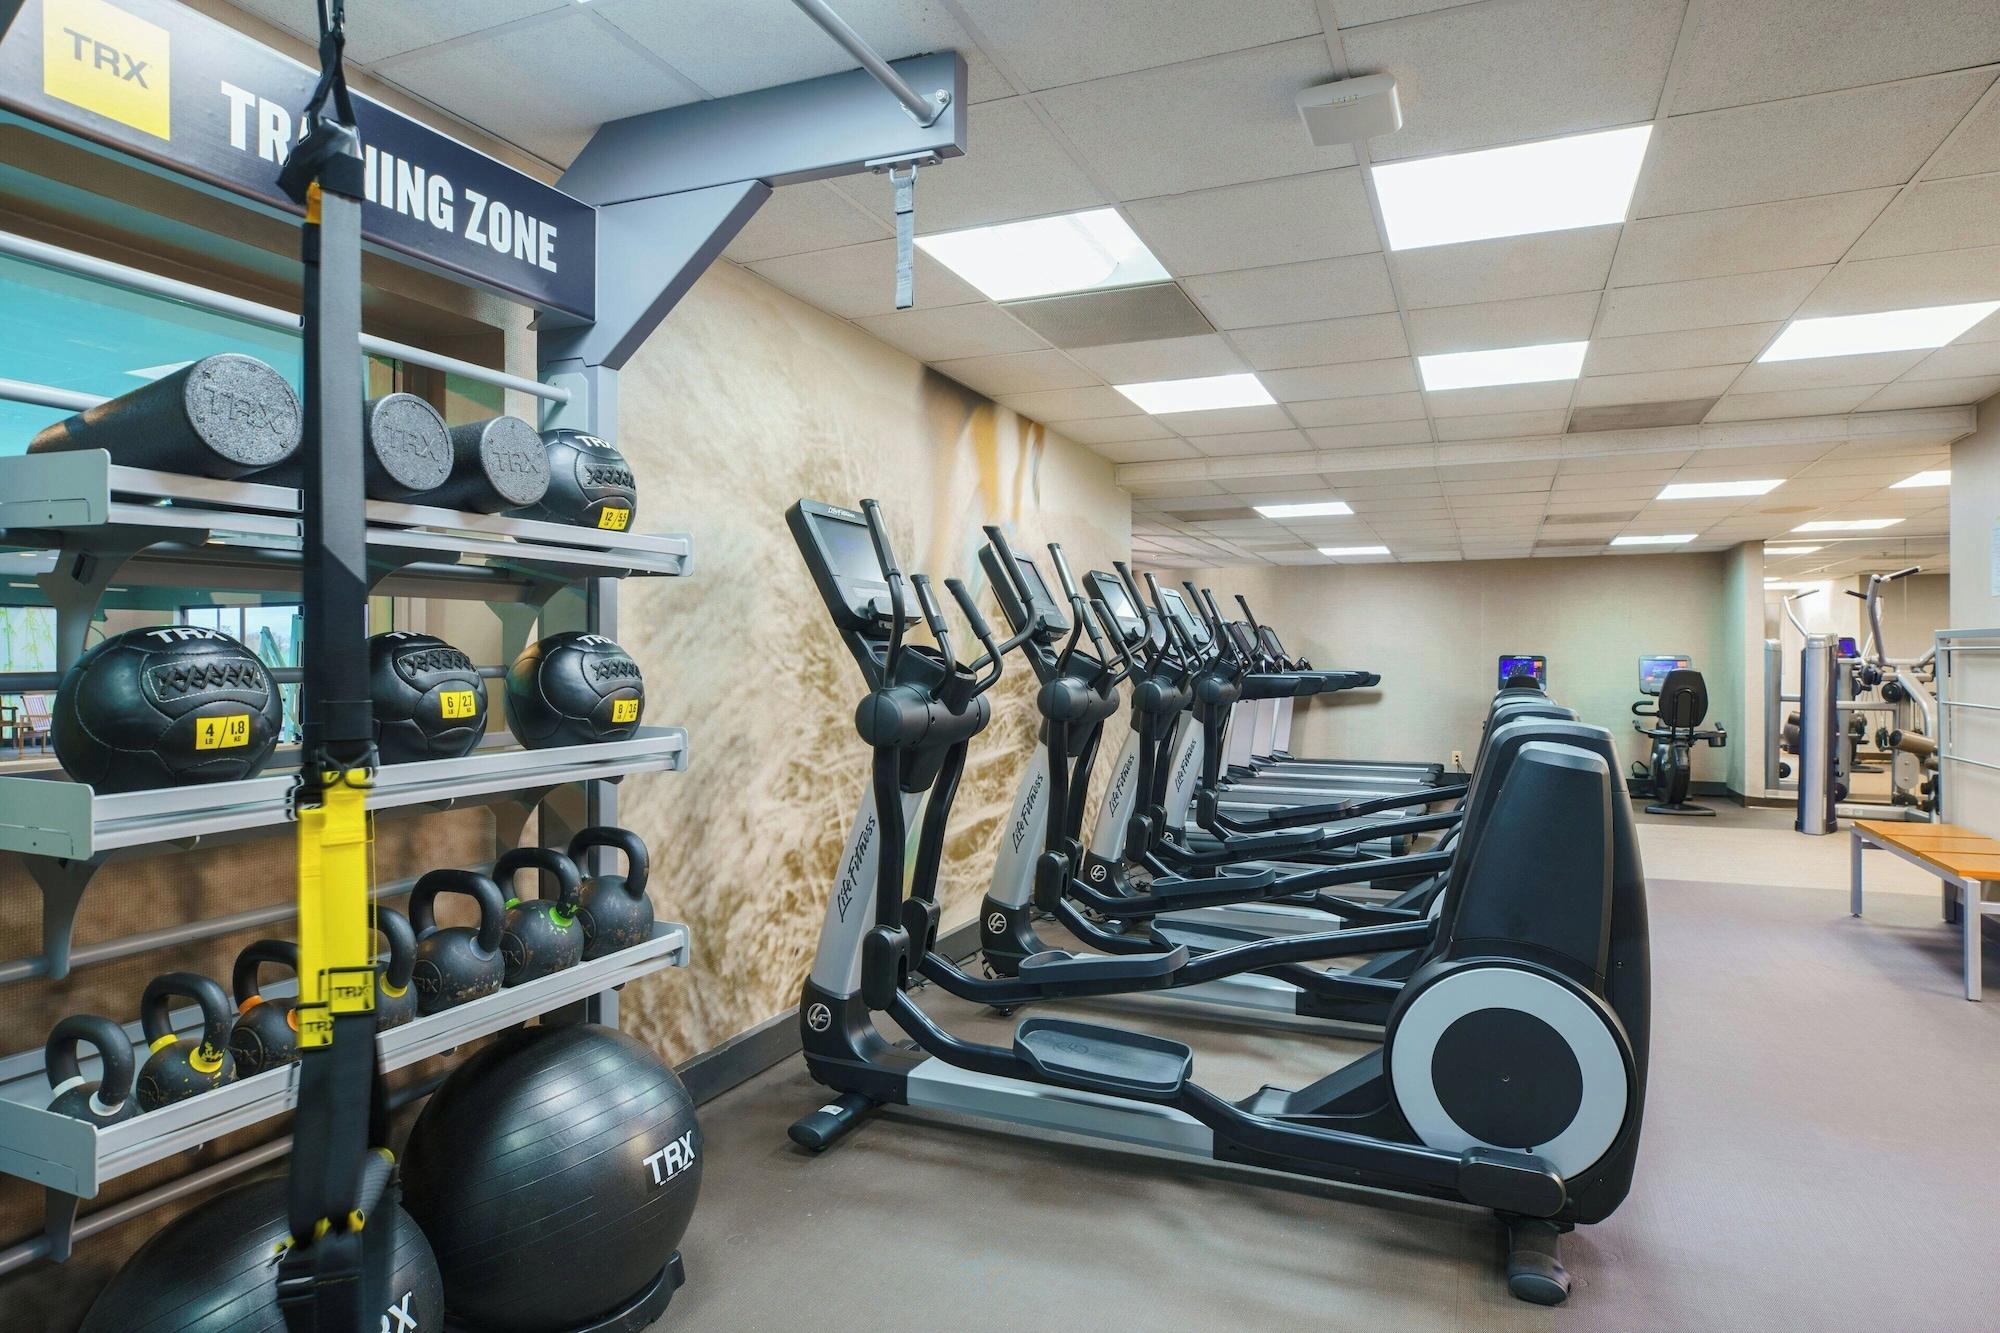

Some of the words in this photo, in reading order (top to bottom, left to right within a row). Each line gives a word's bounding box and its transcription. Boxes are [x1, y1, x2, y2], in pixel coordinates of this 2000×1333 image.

[63, 27, 149, 89] TRX
[221, 80, 453, 232] TRING
[465, 188, 557, 273] ZONE
[203, 385, 284, 435] TRX
[383, 425, 440, 463] TRX
[492, 451, 541, 474] TRX
[448, 696, 454, 708] 6
[206, 723, 214, 737] 4
[231, 721, 245, 735] 1.8
[335, 985, 368, 998] TRX
[643, 1130, 695, 1184] TRX
